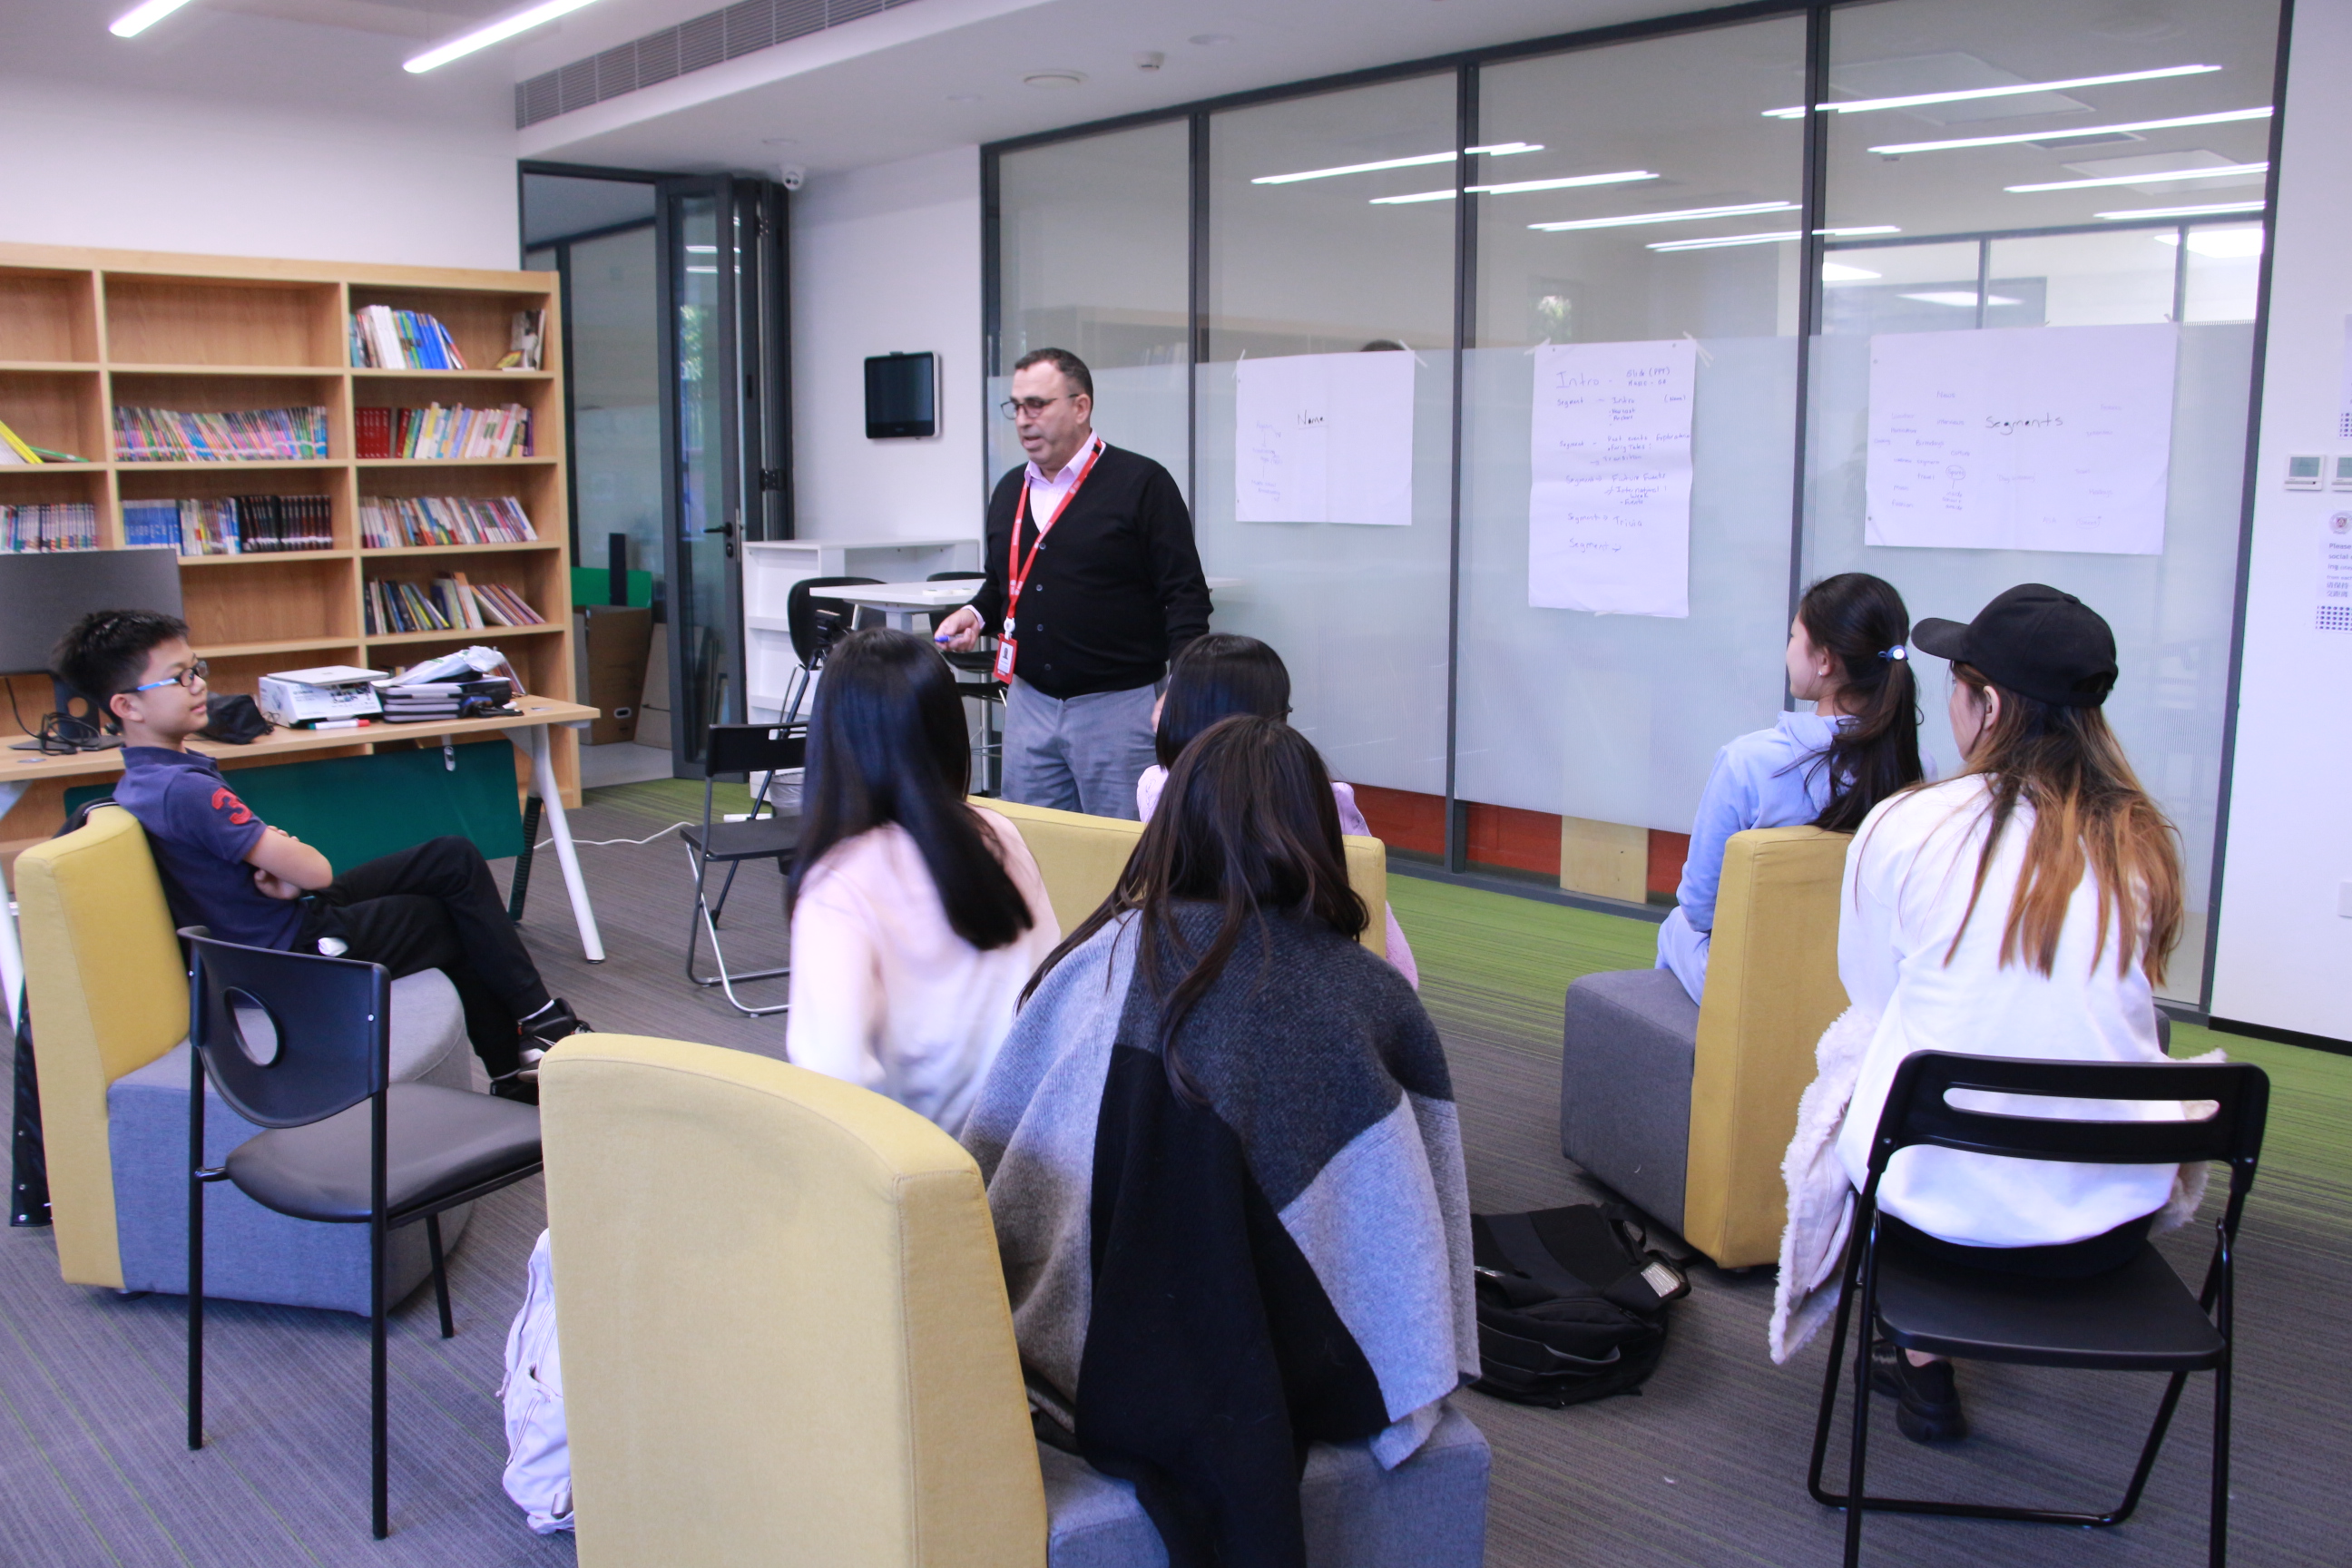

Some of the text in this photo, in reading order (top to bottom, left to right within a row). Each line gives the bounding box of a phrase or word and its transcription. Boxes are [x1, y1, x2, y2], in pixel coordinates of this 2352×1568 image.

[1555, 370, 1600, 389] Intro
[1557, 397, 1583, 408] Segment
[1298, 409, 1325, 426] Name
[1984, 412, 2063, 436] Segments
[1612, 473, 1640, 483] Future
[1568, 512, 1642, 527] Segment Trivia
[1569, 537, 1610, 553] Segment
[212, 788, 253, 825] 3
